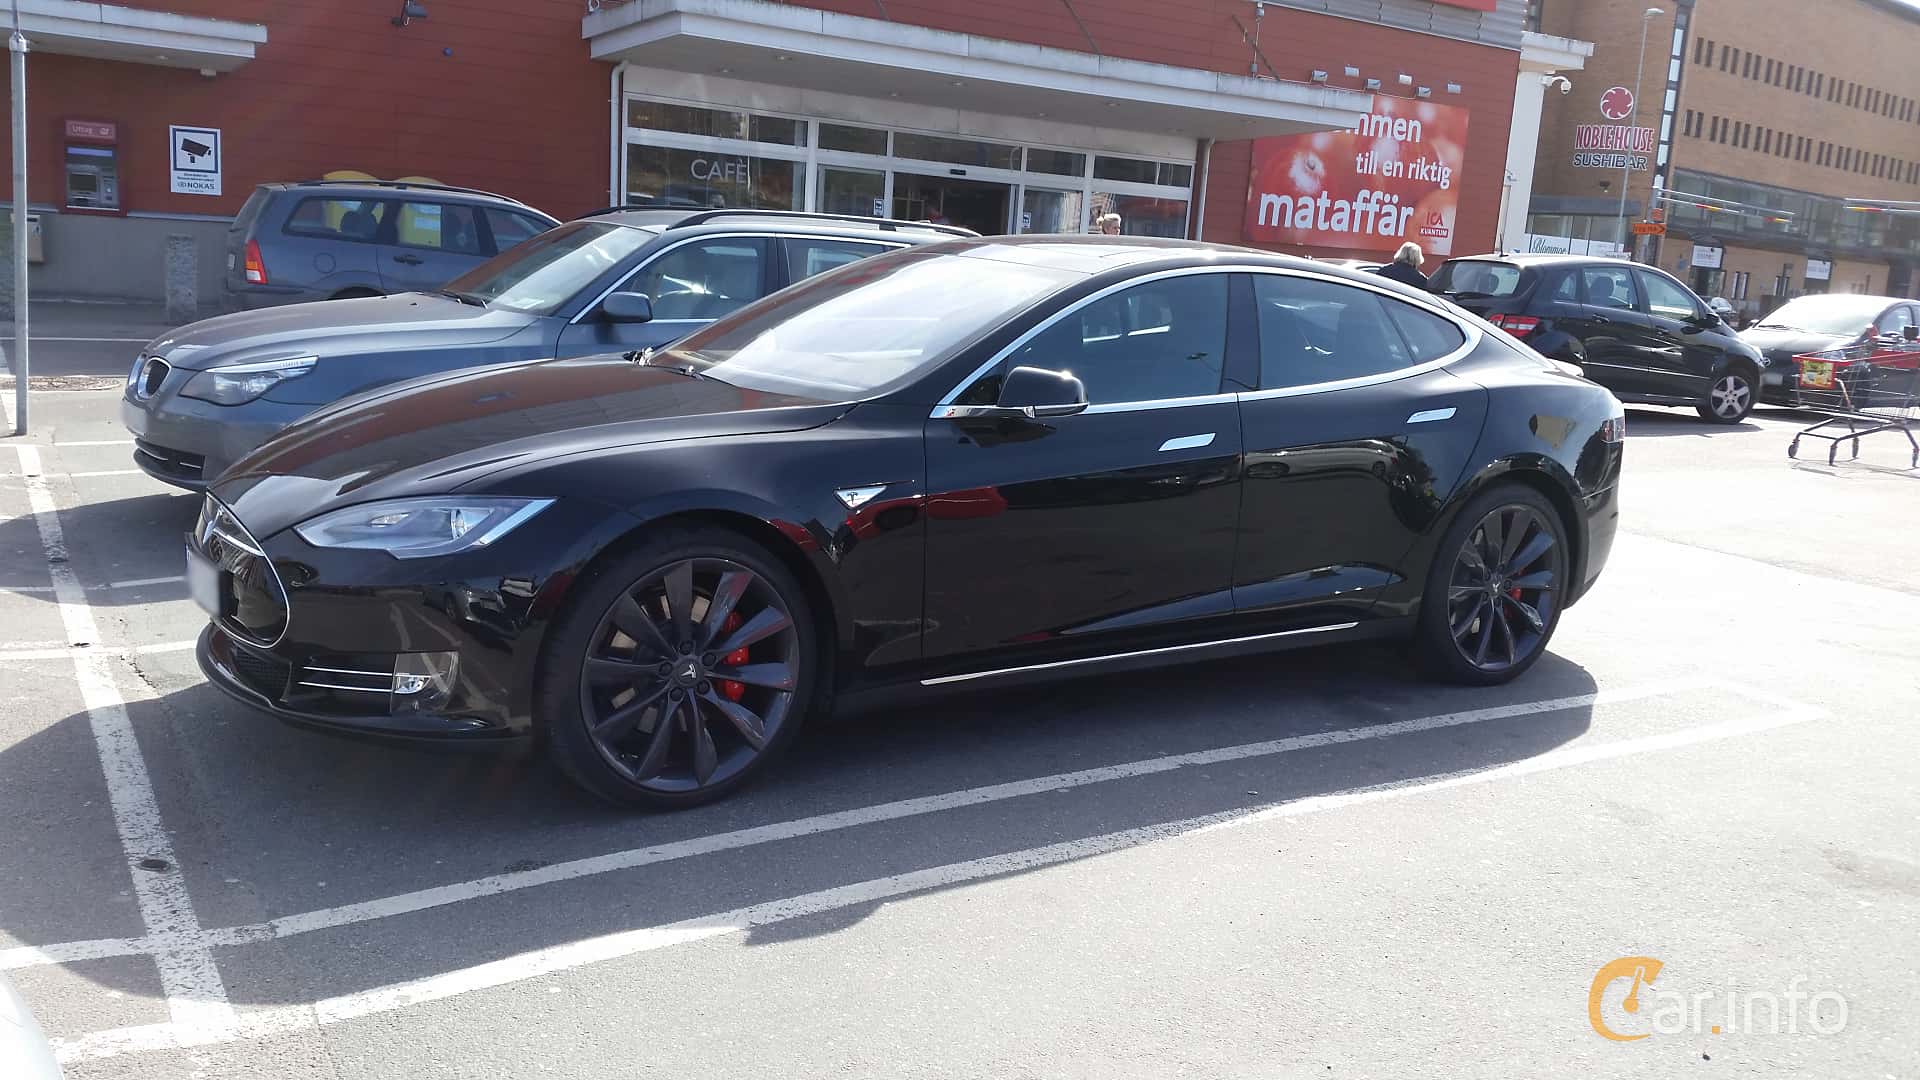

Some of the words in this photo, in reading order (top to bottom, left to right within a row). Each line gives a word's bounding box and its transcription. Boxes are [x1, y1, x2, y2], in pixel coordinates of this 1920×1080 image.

[1345, 111, 1422, 143] mmen
[1356, 151, 1378, 175] till
[1382, 160, 1404, 178] en
[1407, 156, 1453, 190] riktig
[187, 181, 216, 190] NOKAS
[1258, 189, 1415, 237] mataffär
[1426, 211, 1444, 226] ICA
[1420, 228, 1448, 238] KVANTUM
